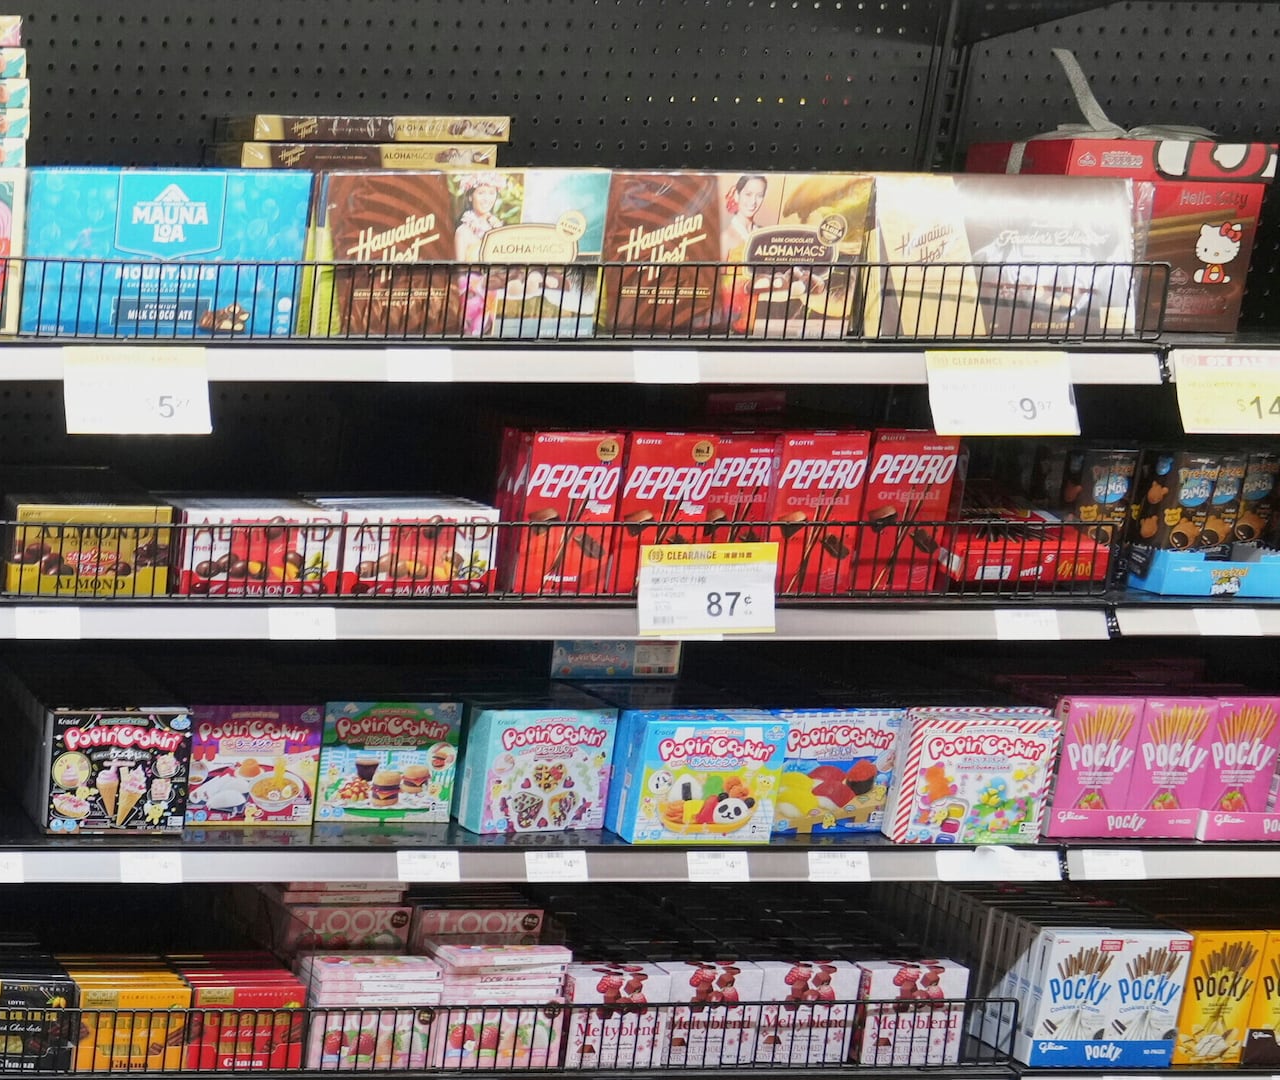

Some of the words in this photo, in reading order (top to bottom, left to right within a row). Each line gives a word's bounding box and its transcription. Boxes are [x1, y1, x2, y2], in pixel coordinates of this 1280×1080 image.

[133, 207, 208, 225] MAUNA
[153, 223, 185, 243] LOA
[347, 213, 436, 257] Hawaiian
[492, 242, 566, 256] ALOHAMACS
[755, 244, 825, 258] ALOHAMACS
[531, 462, 621, 499] PEPERO
[624, 466, 716, 501] PEPERO
[786, 495, 850, 508] original
[878, 489, 940, 501] original
[667, 551, 717, 560] CLEARANCE
[245, 584, 294, 595] ALMOND
[1068, 738, 1131, 774] POCKY
[1143, 739, 1207, 776] POCKY
[307, 907, 391, 936] LOOK
[223, 1056, 263, 1069] Ghana
